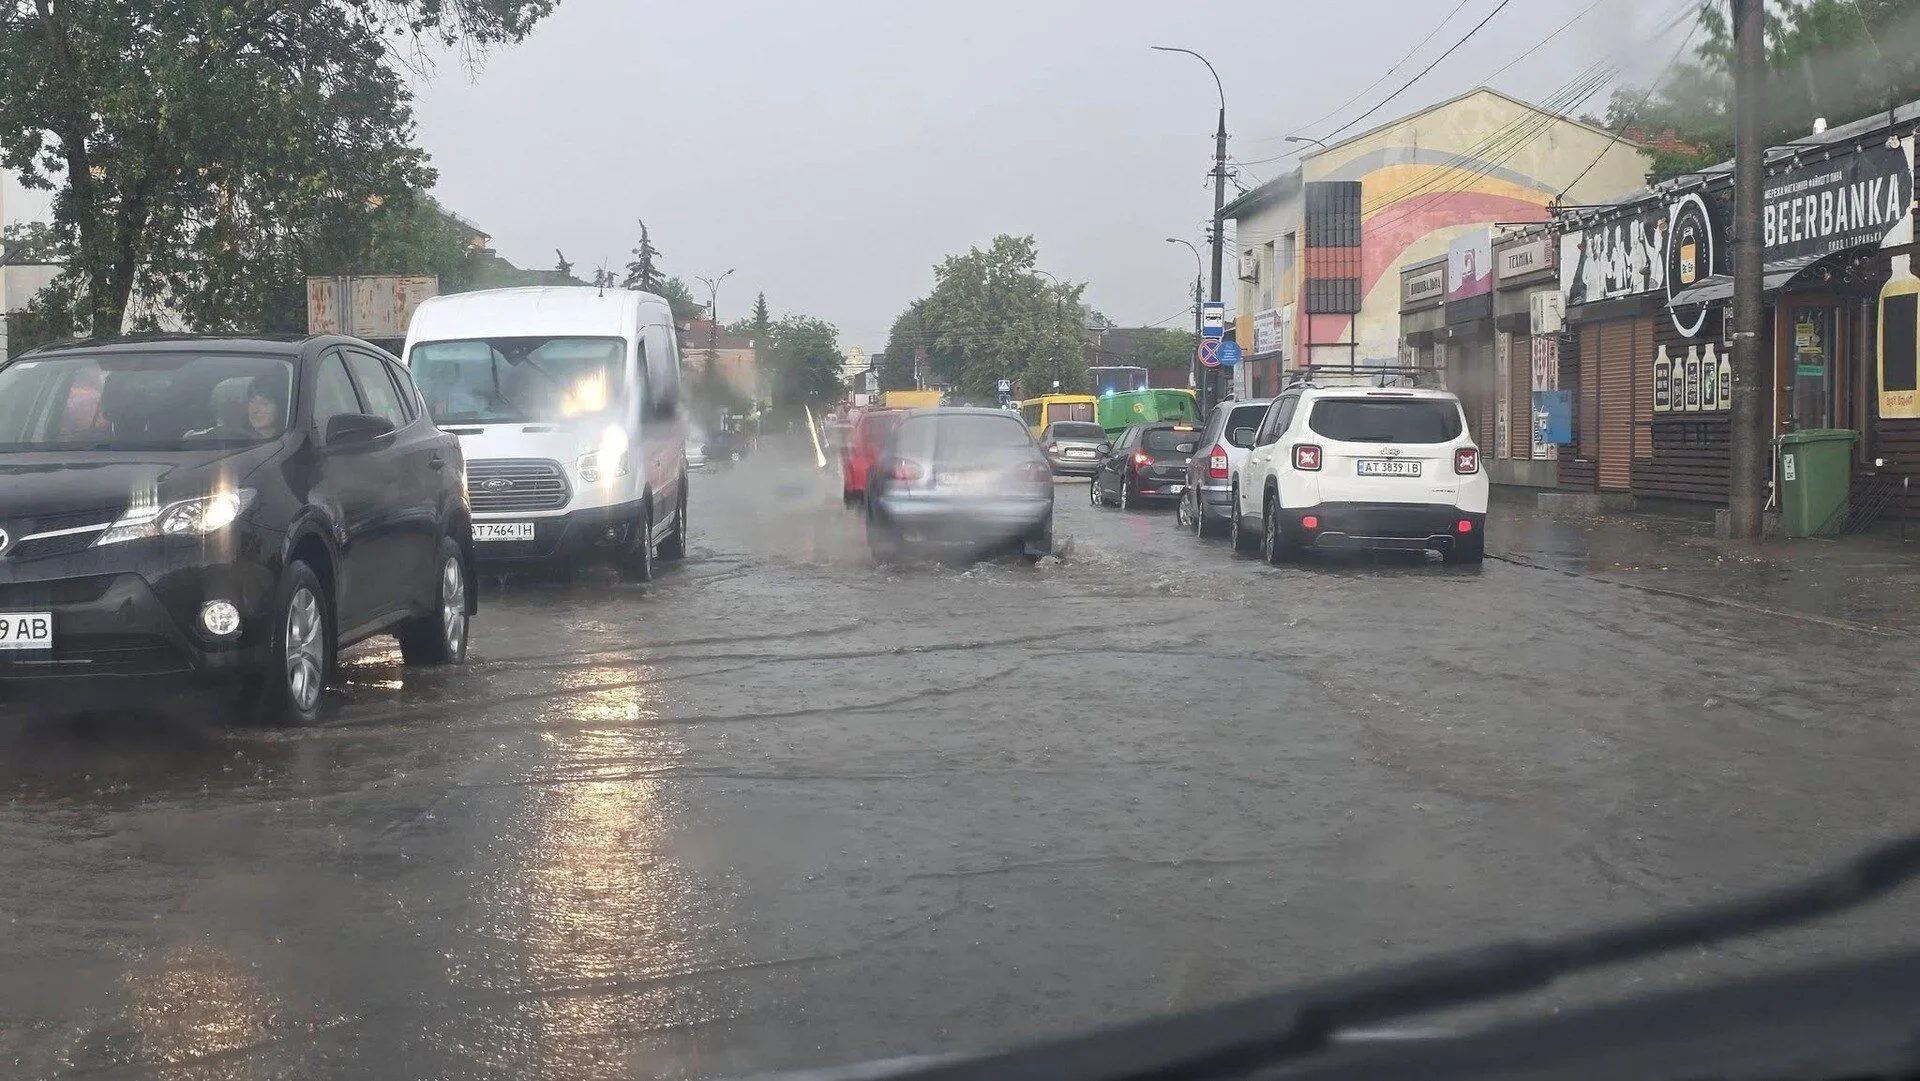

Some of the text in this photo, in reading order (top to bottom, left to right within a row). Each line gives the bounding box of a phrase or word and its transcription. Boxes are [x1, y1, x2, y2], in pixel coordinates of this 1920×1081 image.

[1764, 173, 1901, 248] BEERBANKA
[1365, 462, 1419, 473] AT 3839 IB
[487, 525, 514, 536] 7464
[518, 524, 532, 536] IH
[0, 618, 48, 640] 9 AB
